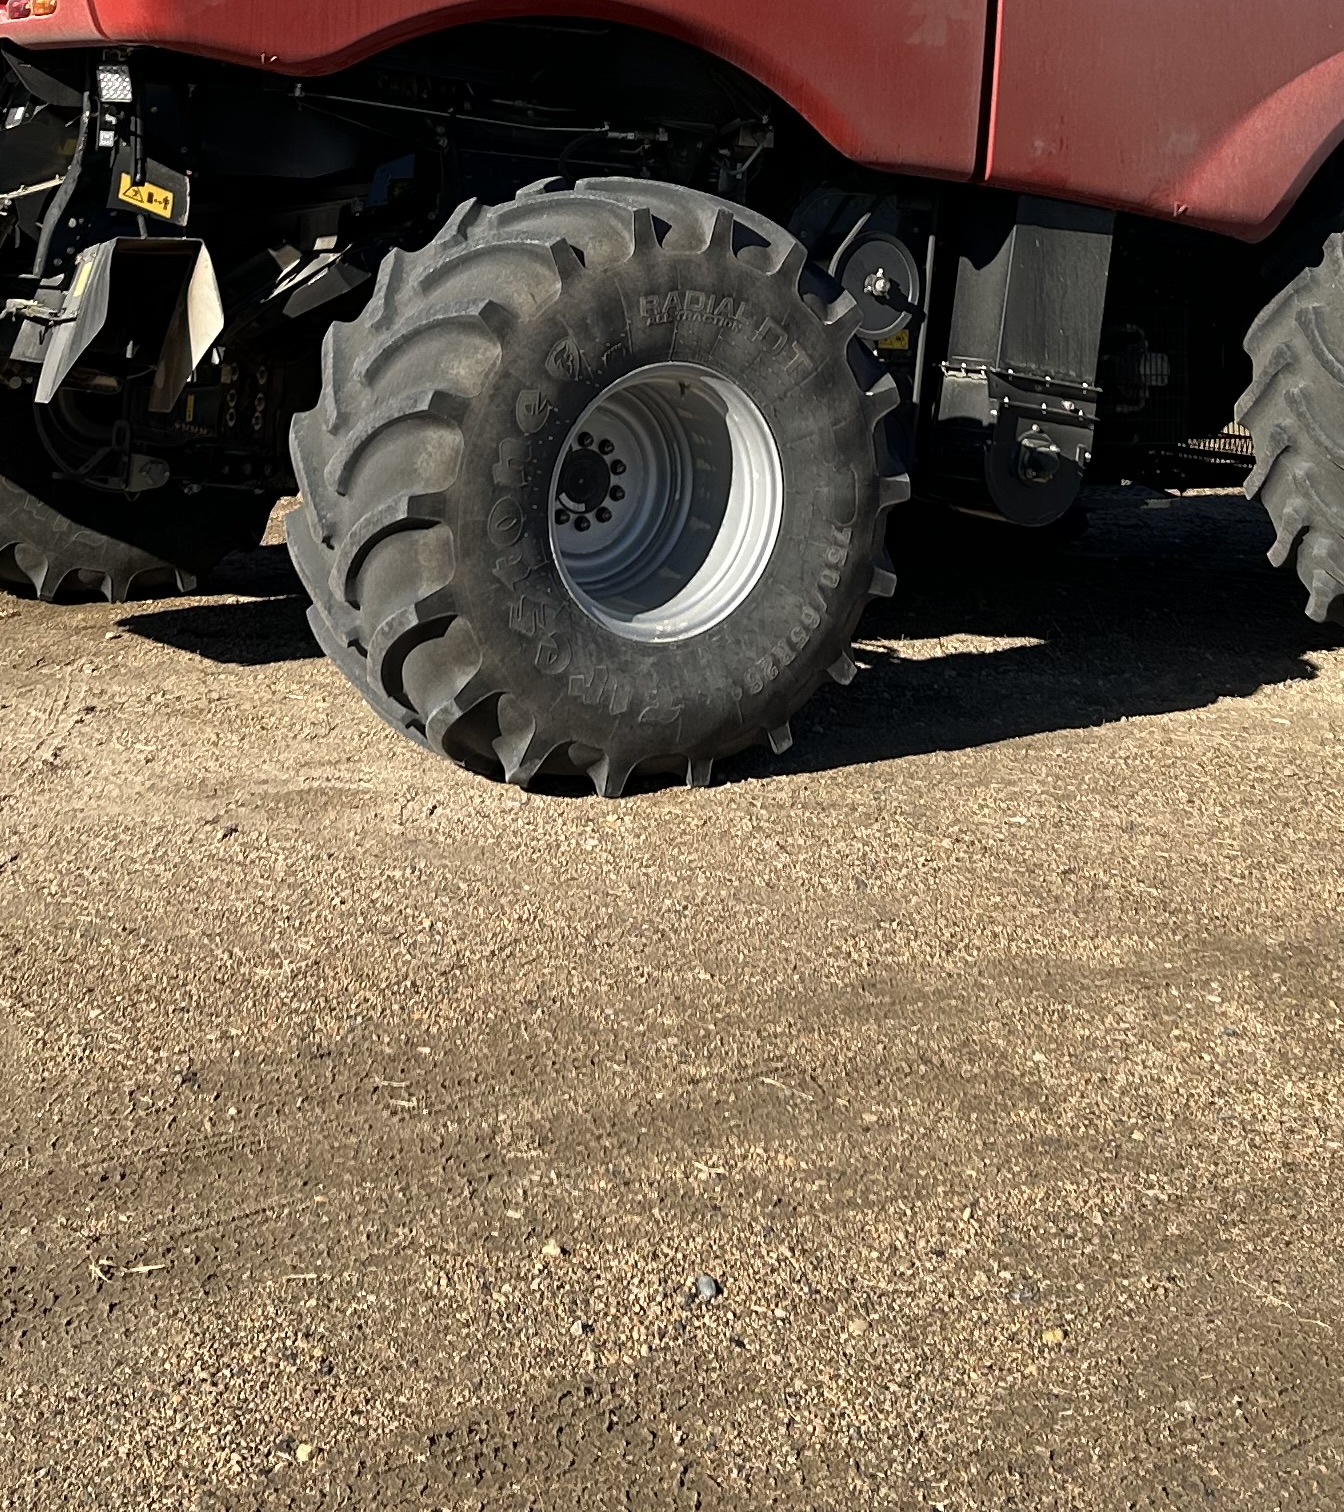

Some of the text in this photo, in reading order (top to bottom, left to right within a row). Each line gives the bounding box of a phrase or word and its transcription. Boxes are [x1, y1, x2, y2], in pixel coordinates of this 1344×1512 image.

[639, 289, 814, 376] RADIAL DT
[646, 309, 743, 334] ALL TRACTION
[744, 524, 853, 696] 750/65R26
